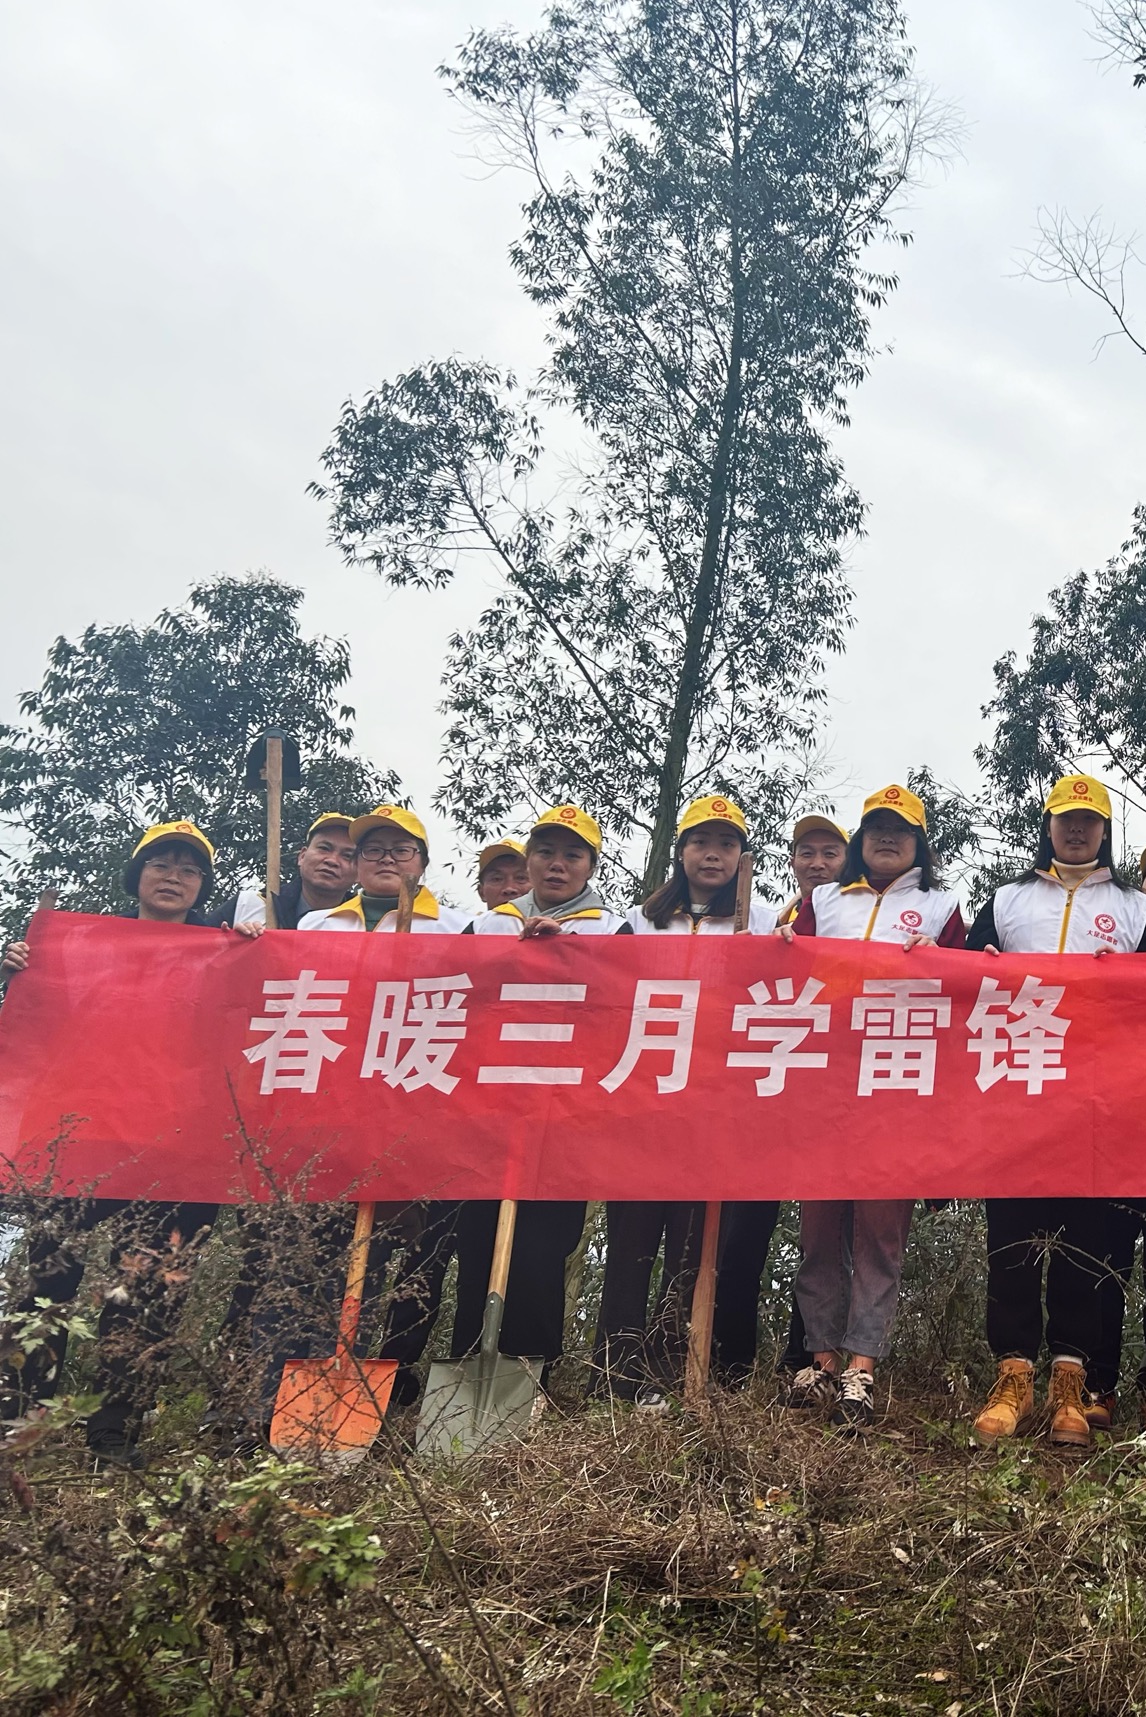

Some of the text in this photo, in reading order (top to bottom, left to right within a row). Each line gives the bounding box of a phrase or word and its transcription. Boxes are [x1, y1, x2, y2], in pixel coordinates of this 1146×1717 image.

[1086, 929, 1119, 946] 大足志愿者
[242, 970, 1072, 1097] 春暖三月学雷锋
